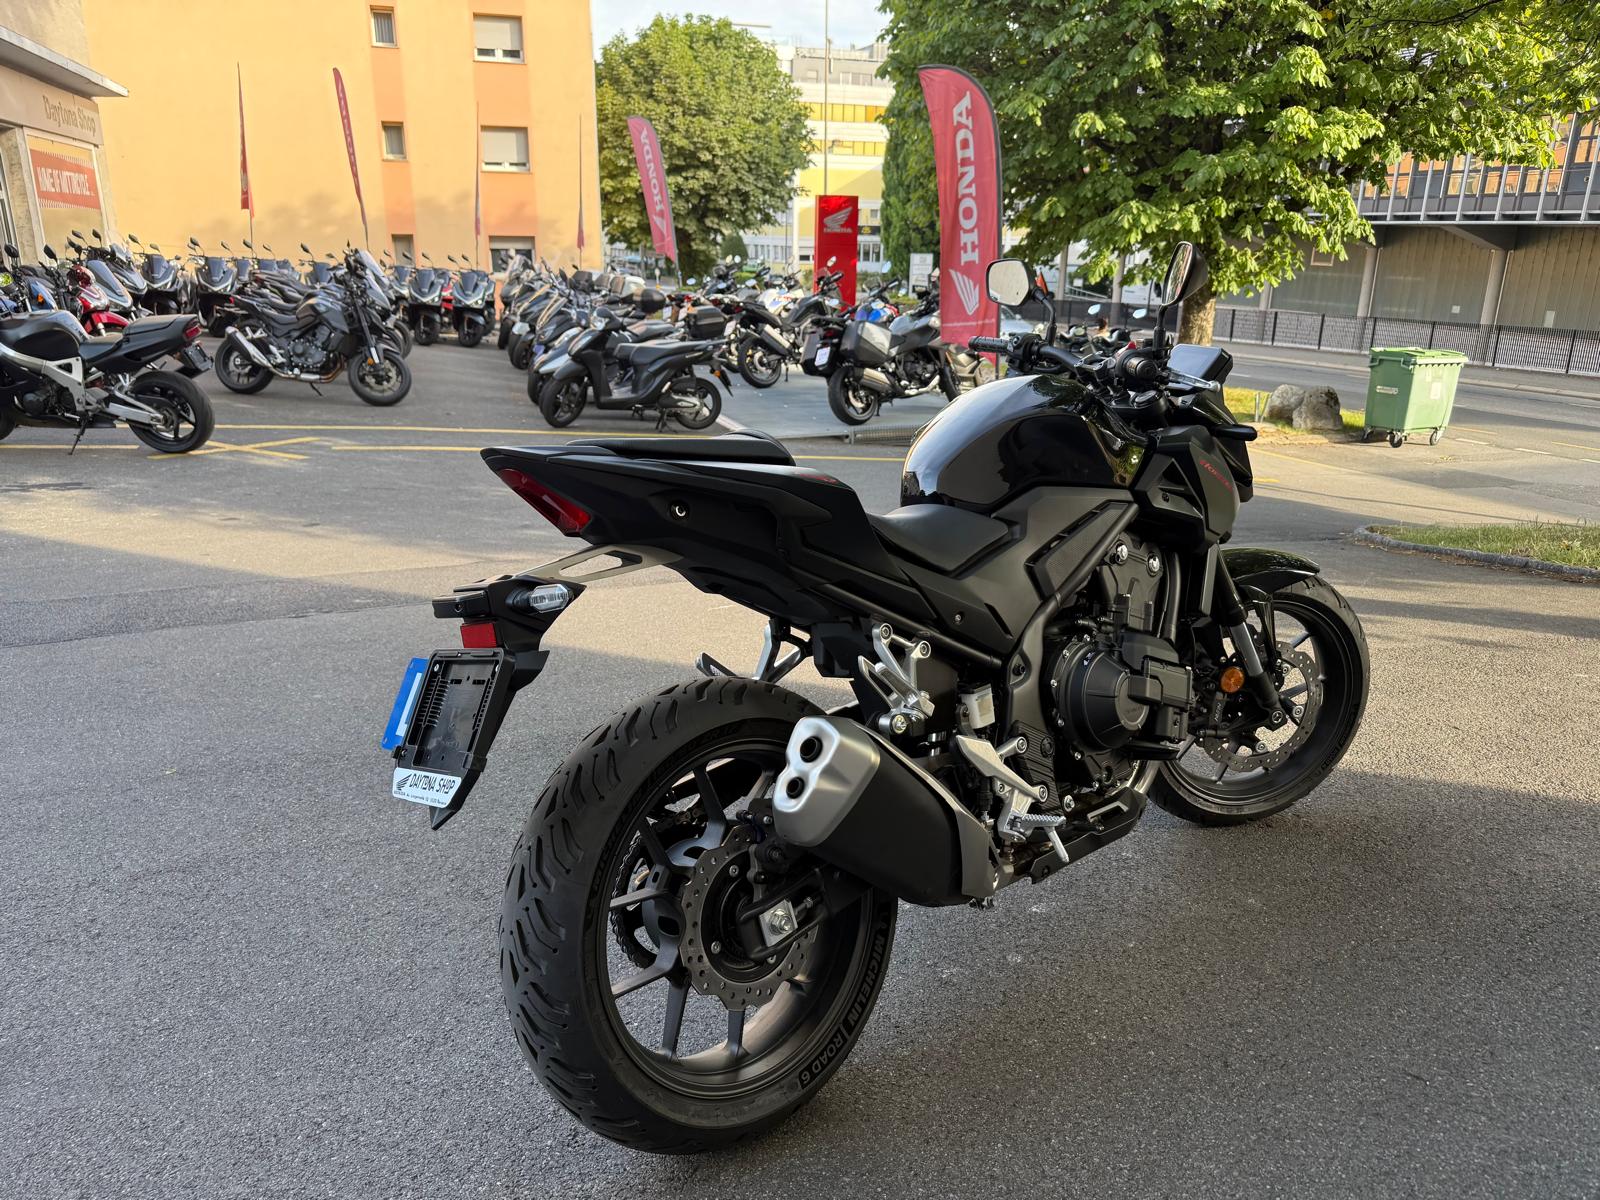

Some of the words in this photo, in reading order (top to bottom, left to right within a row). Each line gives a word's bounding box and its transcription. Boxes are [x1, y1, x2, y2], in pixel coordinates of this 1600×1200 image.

[42, 95, 78, 128] Daytona
[77, 107, 97, 137] Shop
[640, 127, 664, 212] HONDA
[952, 91, 979, 266] HONDA
[408, 773, 438, 792] DAYTONA
[436, 777, 456, 794] SHOP
[849, 935, 887, 1029] MICHELIN
[811, 1031, 845, 1073] ROAD
[801, 1070, 812, 1085] 6
